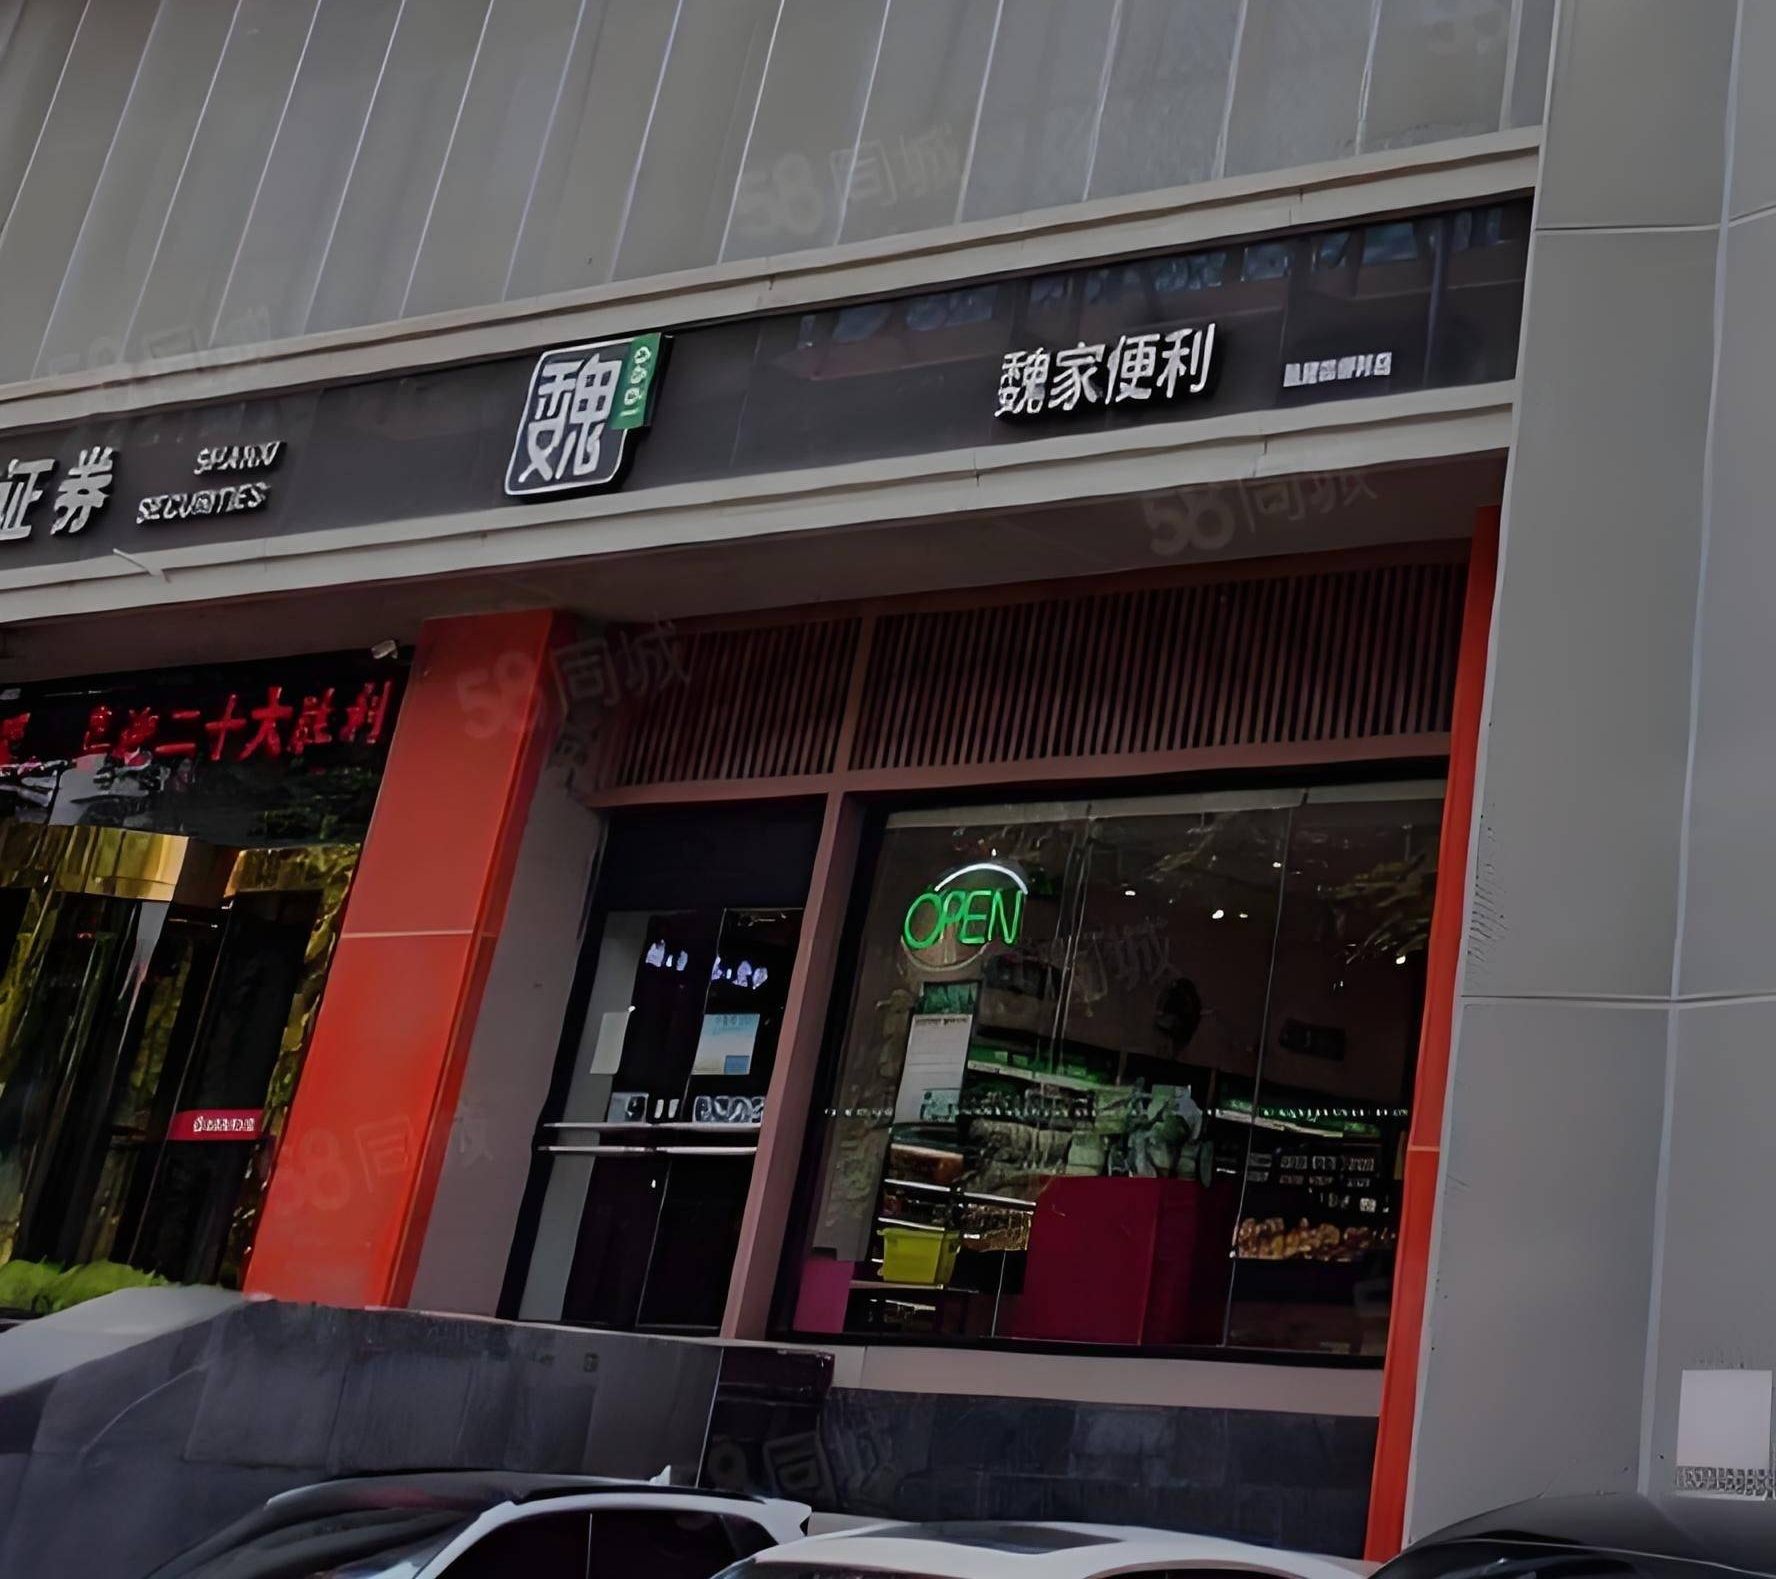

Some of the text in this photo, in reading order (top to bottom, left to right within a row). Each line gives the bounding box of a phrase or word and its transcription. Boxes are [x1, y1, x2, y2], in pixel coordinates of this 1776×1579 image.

[517, 353, 623, 484] 魏
[994, 323, 1217, 419] 魏家便利
[0, 446, 116, 541] 证券
[904, 889, 1024, 951] OPEN
